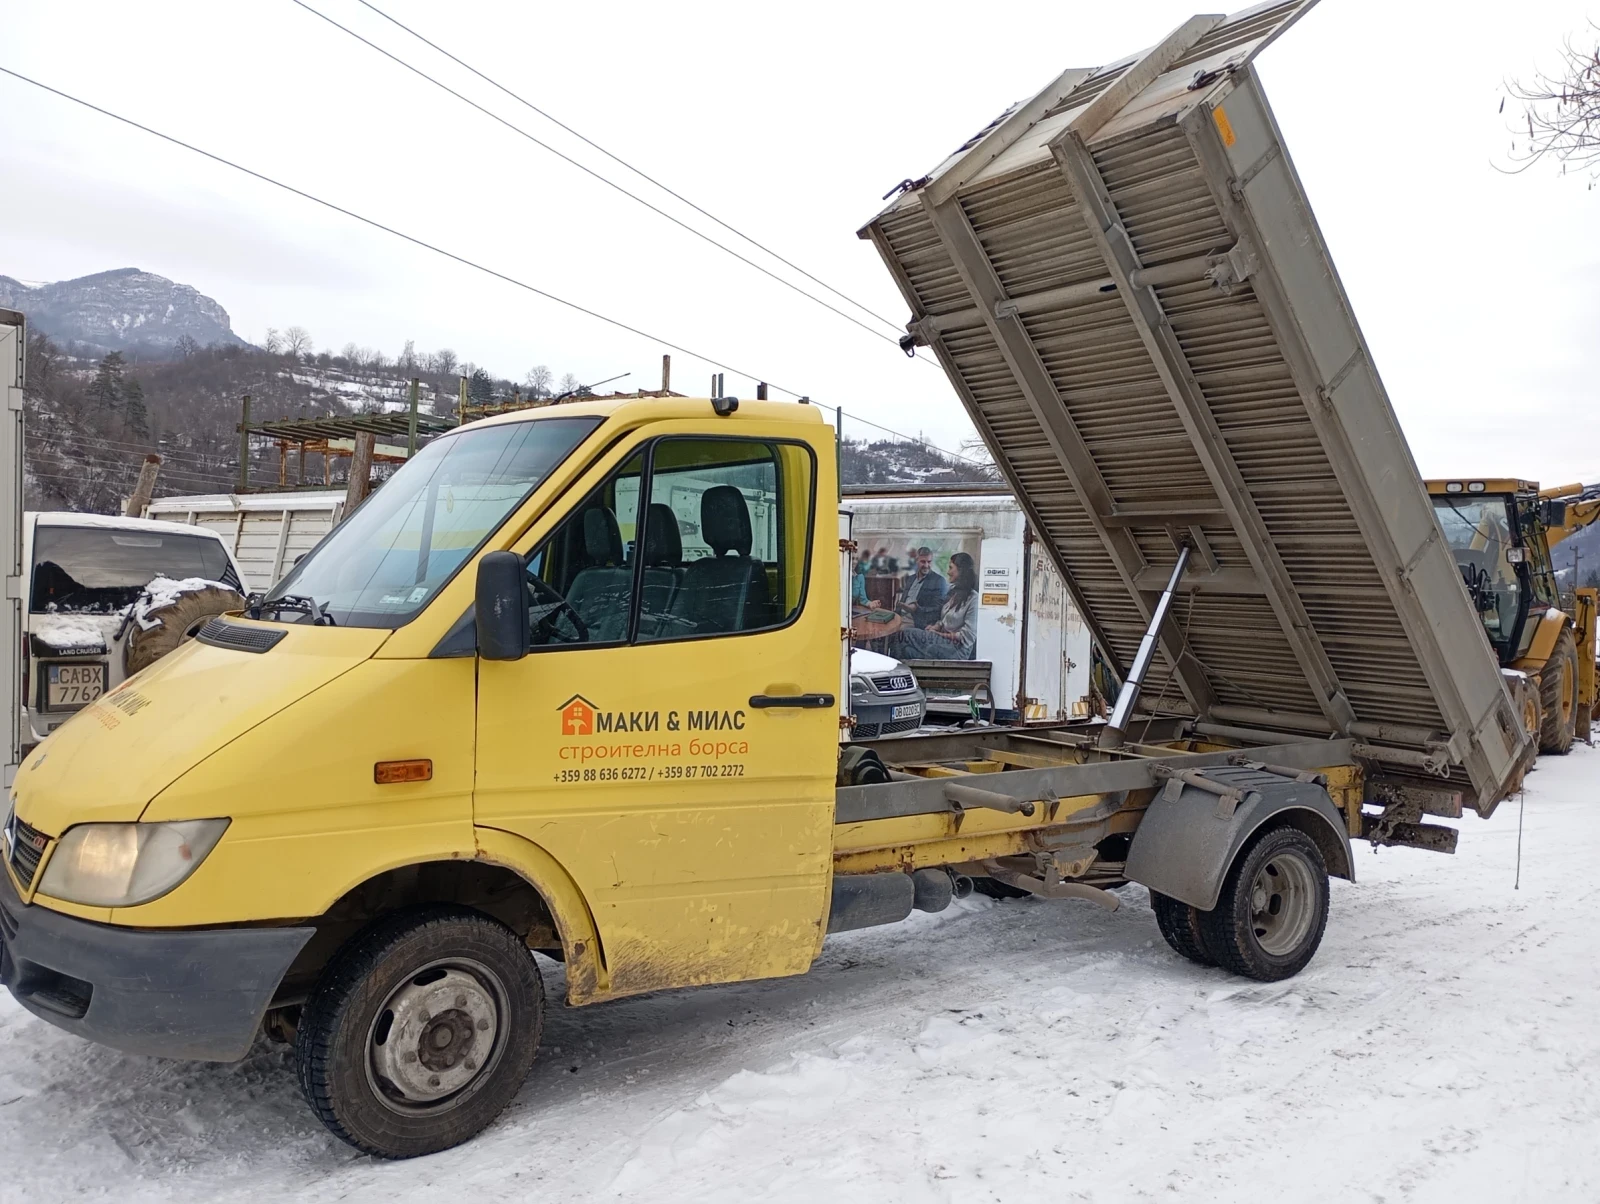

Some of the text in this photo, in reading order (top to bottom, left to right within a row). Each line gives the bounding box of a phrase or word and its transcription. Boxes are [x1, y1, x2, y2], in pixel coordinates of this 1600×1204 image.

[59, 686, 102, 703] 7762
[596, 710, 746, 733] МАКИ & МИЛС
[558, 738, 749, 764] строителна борса
[553, 770, 580, 783] +359
[583, 769, 597, 781] 88
[599, 768, 619, 781] 636
[621, 767, 647, 780] 6272
[657, 766, 683, 779] +359
[685, 766, 698, 778] 87
[700, 765, 718, 778] 702
[720, 765, 745, 777] 2272
